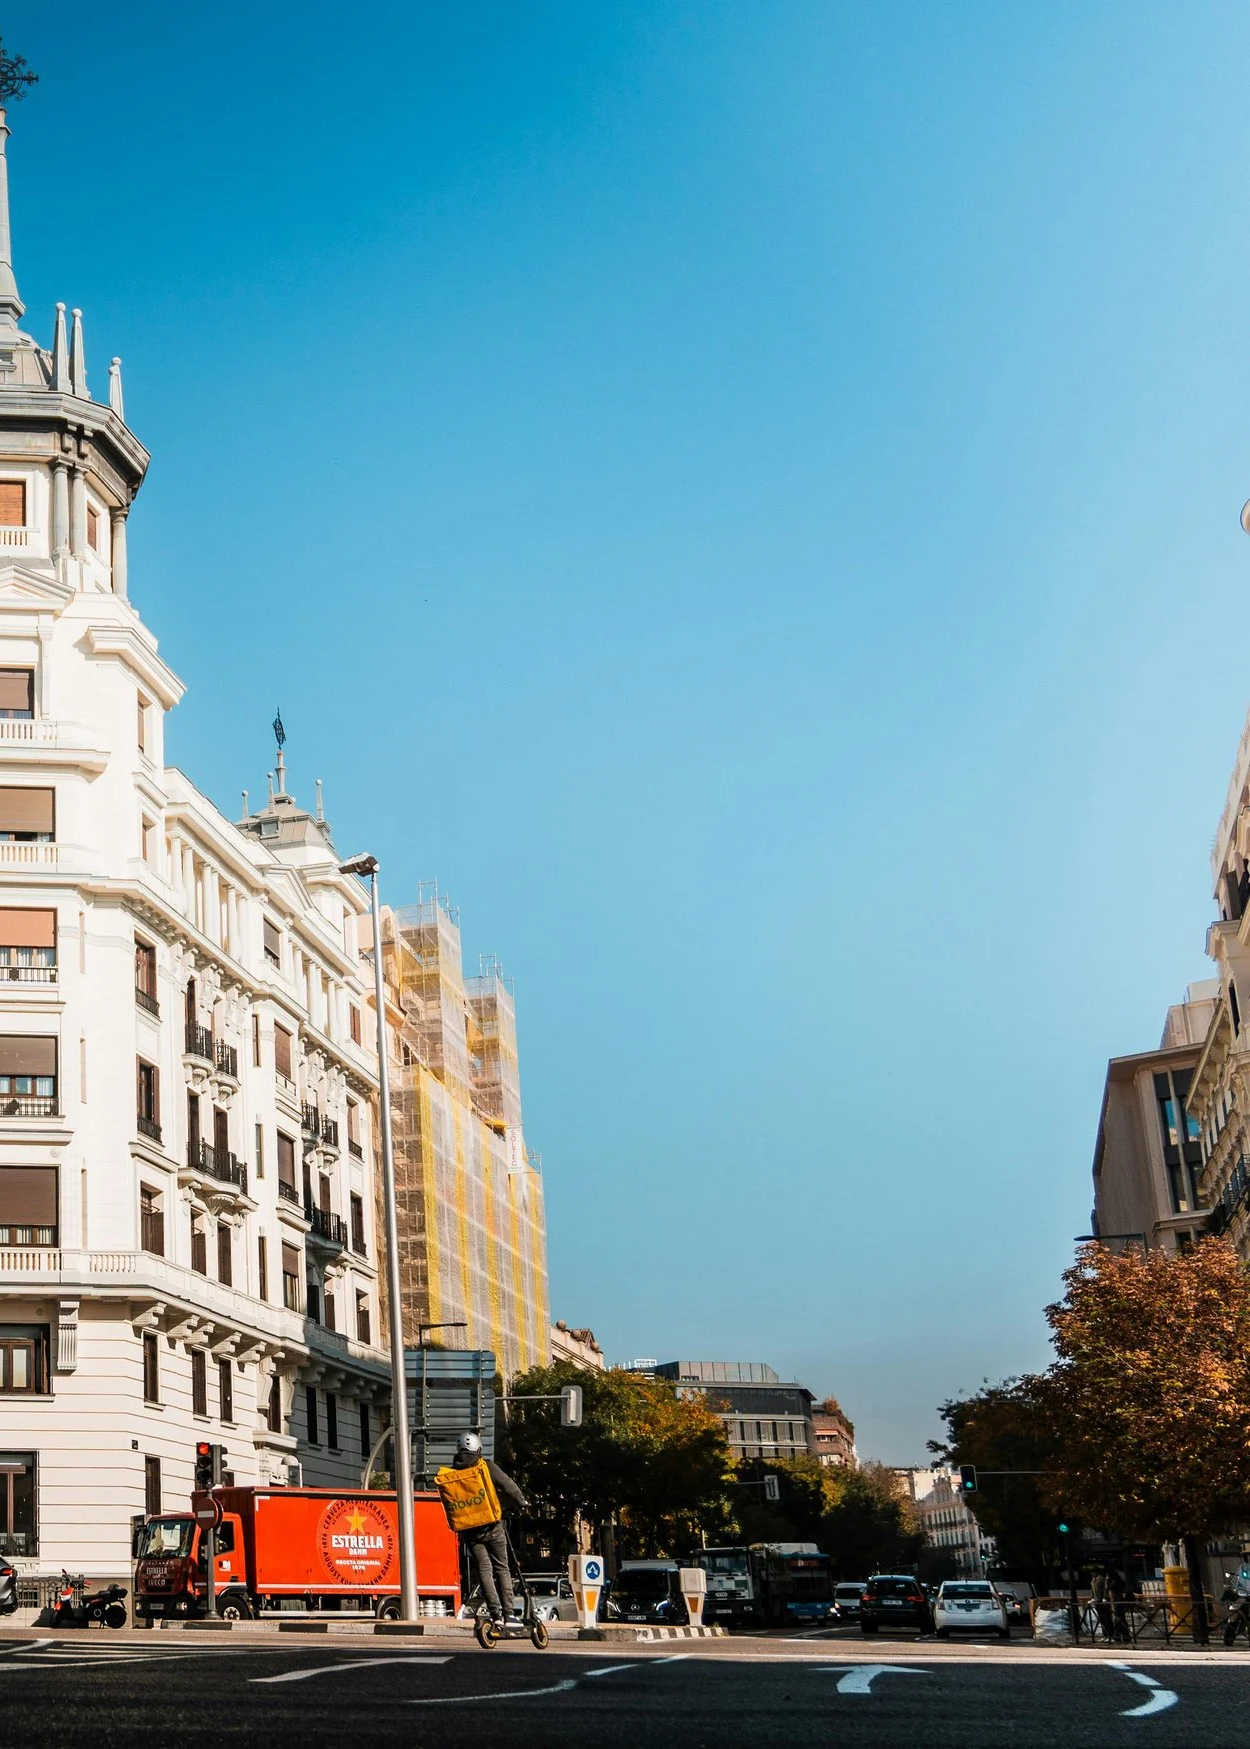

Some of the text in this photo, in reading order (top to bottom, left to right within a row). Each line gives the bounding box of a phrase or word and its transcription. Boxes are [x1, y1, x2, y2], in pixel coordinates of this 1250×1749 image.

[323, 1501, 345, 1530] CERVEZA
[331, 1535, 383, 1549] ESTRELLA
[323, 1552, 341, 1579] AUGUST
